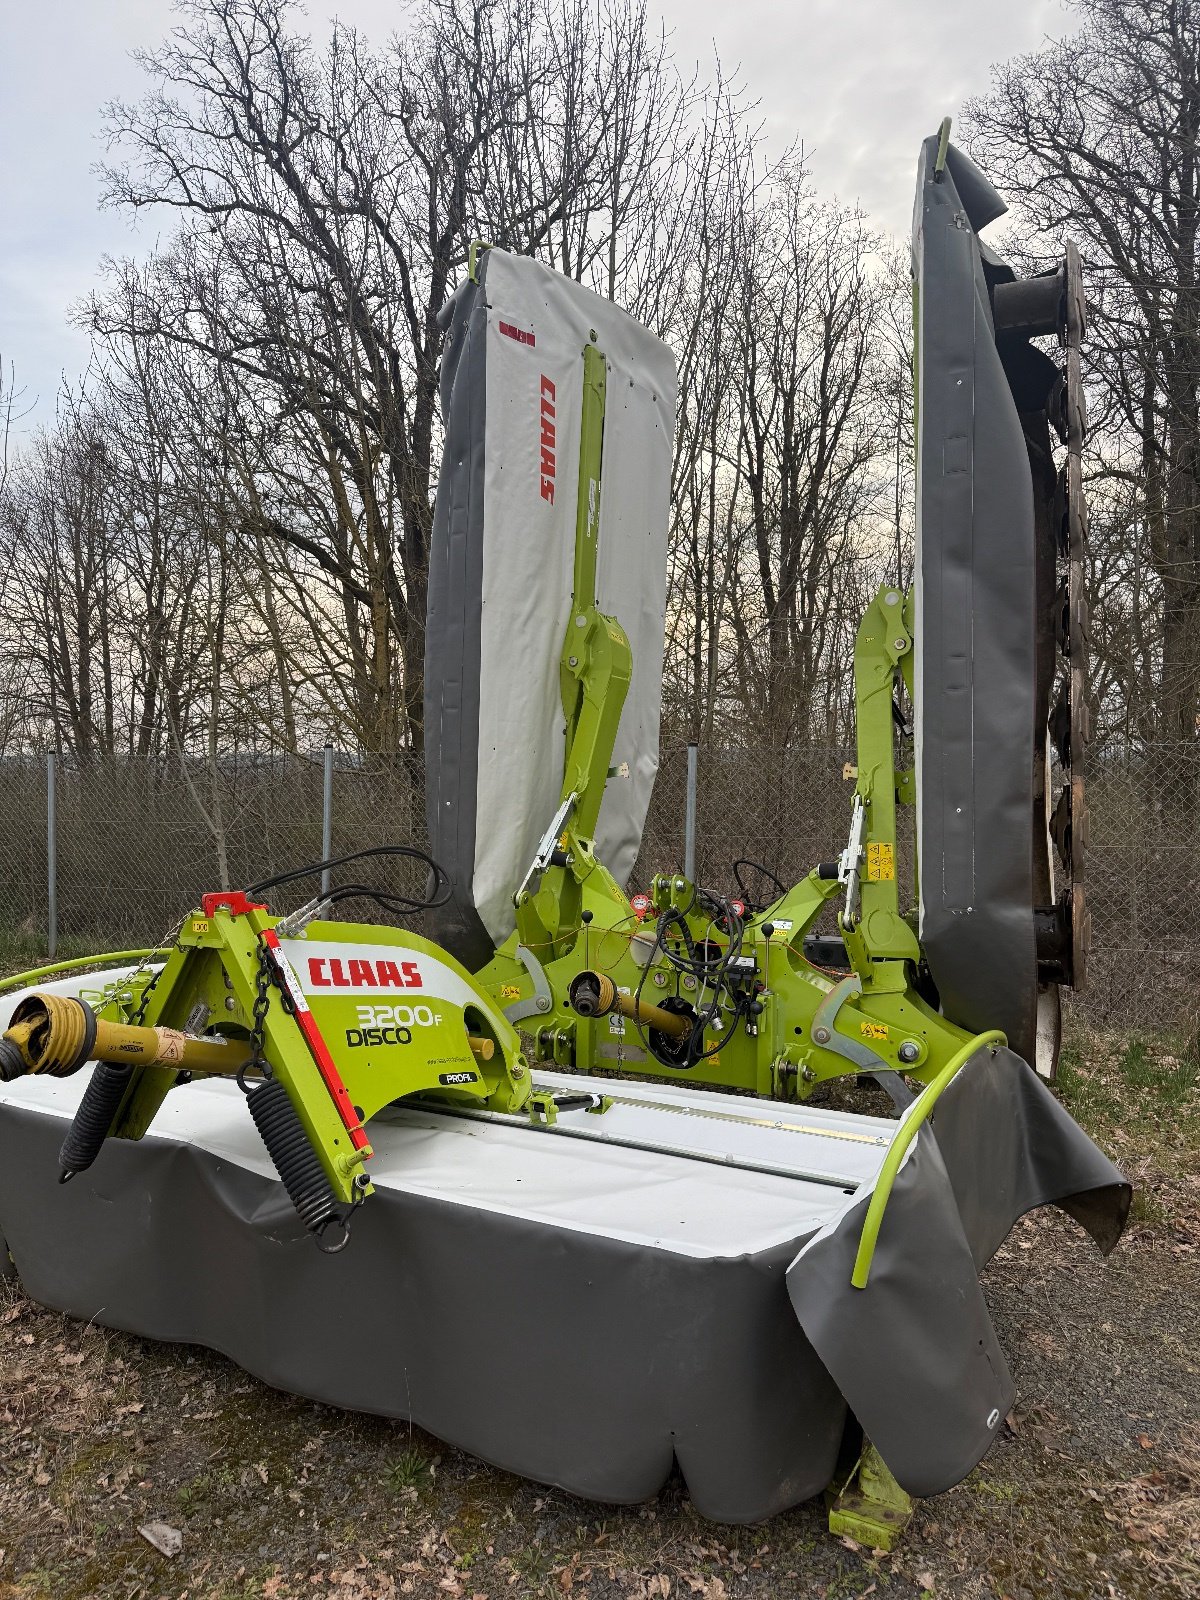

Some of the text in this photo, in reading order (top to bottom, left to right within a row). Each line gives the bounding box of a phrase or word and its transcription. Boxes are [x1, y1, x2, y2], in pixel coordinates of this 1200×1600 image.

[540, 373, 556, 506] CLAAS
[307, 957, 423, 987] CLAAS
[345, 1027, 412, 1047] DISCO
